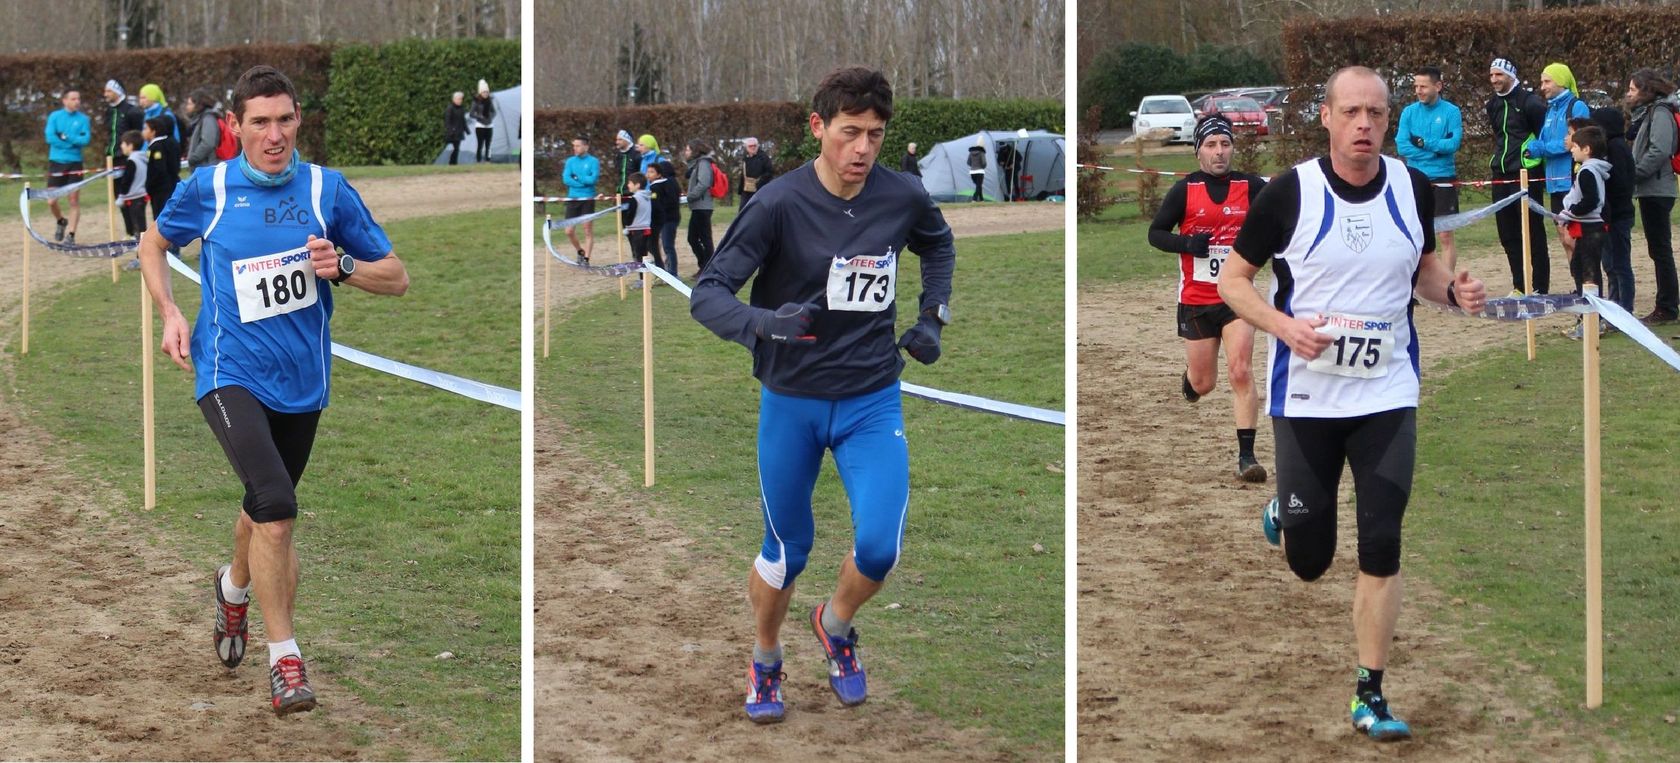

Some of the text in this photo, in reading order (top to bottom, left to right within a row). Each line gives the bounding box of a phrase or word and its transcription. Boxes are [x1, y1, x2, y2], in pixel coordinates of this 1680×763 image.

[264, 208, 310, 225] BAC
[248, 250, 311, 273] INTERSPORT
[1209, 258, 1226, 278] 9
[256, 269, 307, 308] 180
[845, 271, 890, 303] 173
[1330, 316, 1393, 332] INTERSPORT
[1333, 335, 1382, 370] 175
[213, 393, 232, 428] SALOMON
